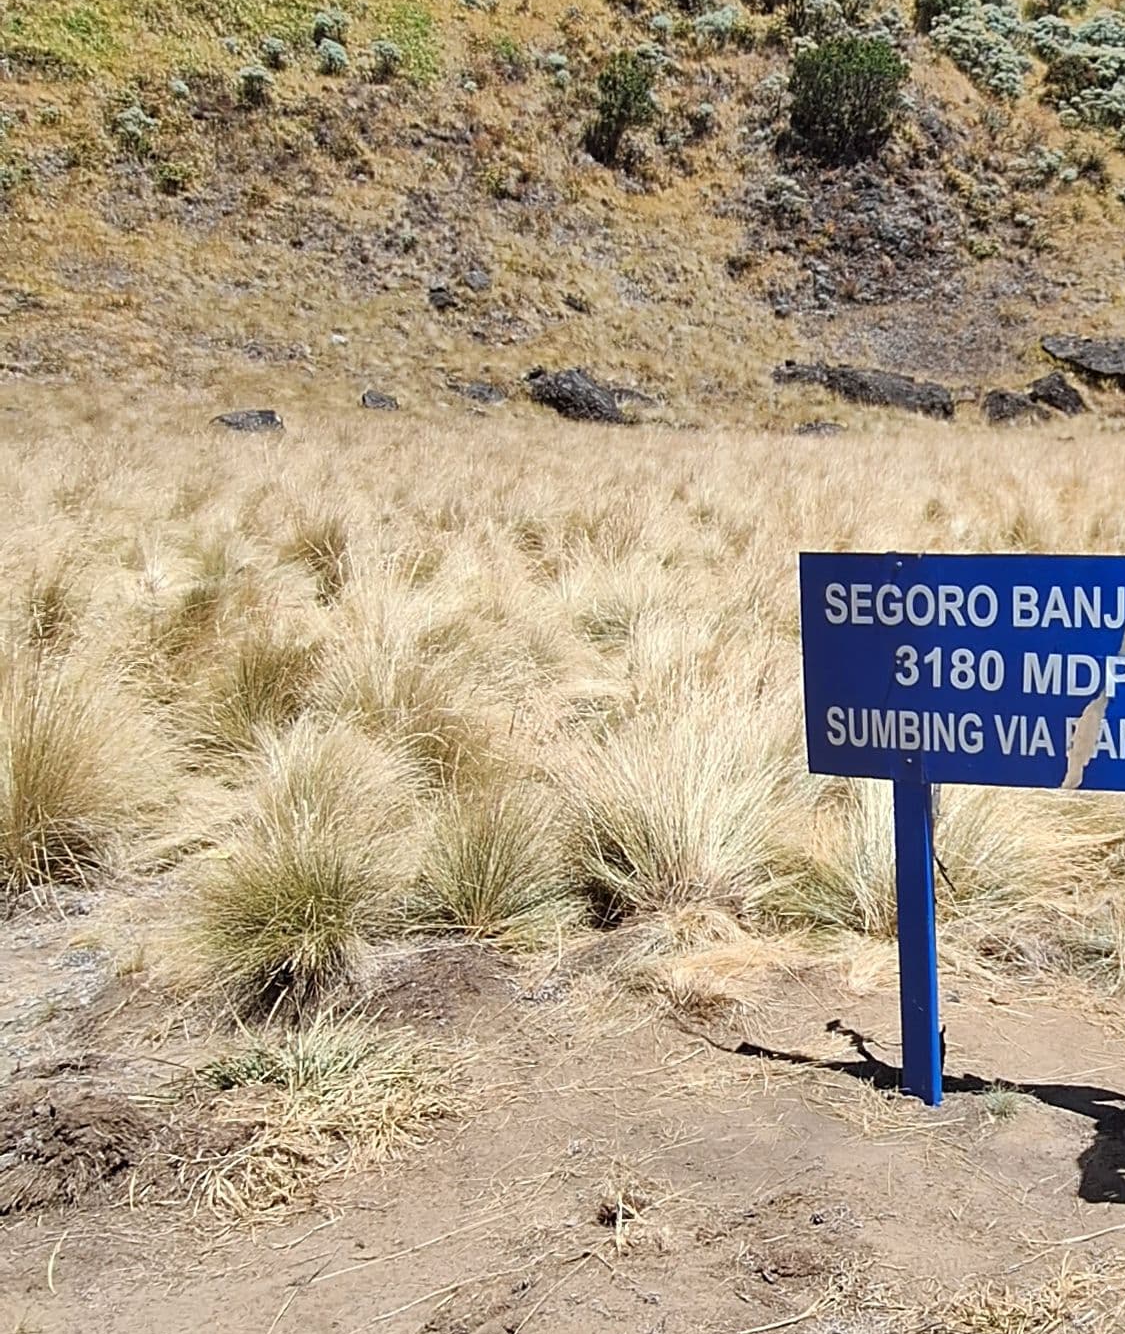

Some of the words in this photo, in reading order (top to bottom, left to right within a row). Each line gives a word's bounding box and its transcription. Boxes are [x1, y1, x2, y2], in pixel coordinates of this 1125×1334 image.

[825, 583, 998, 628] SEGORO
[895, 645, 1005, 692] 3180
[826, 706, 984, 754] SUMBING
[994, 714, 1056, 757] VIA
